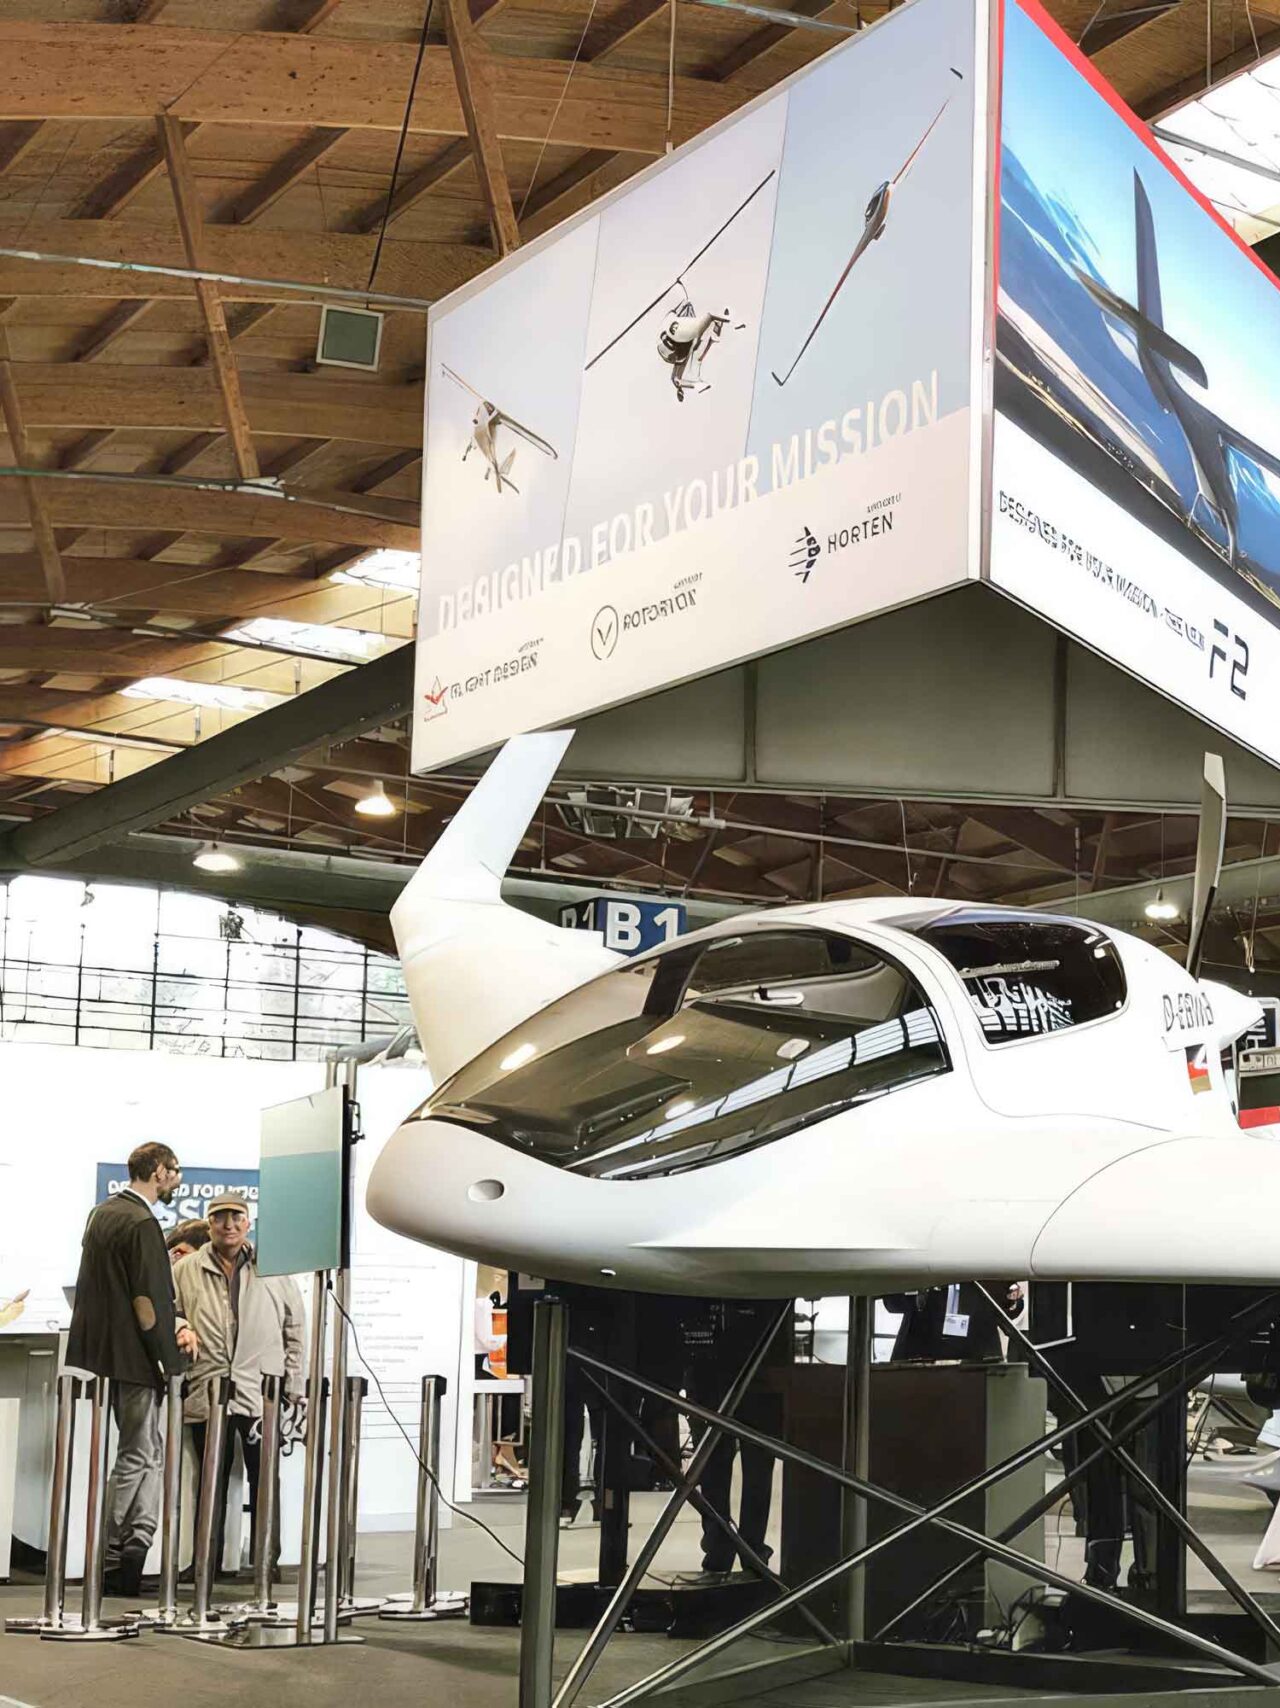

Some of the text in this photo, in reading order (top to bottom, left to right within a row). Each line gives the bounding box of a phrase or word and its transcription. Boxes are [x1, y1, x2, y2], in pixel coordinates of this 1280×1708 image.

[438, 367, 938, 631] DESIGNED FOR YOUR MISSION
[827, 511, 893, 553] HORTEN
[1209, 618, 1250, 701] F2
